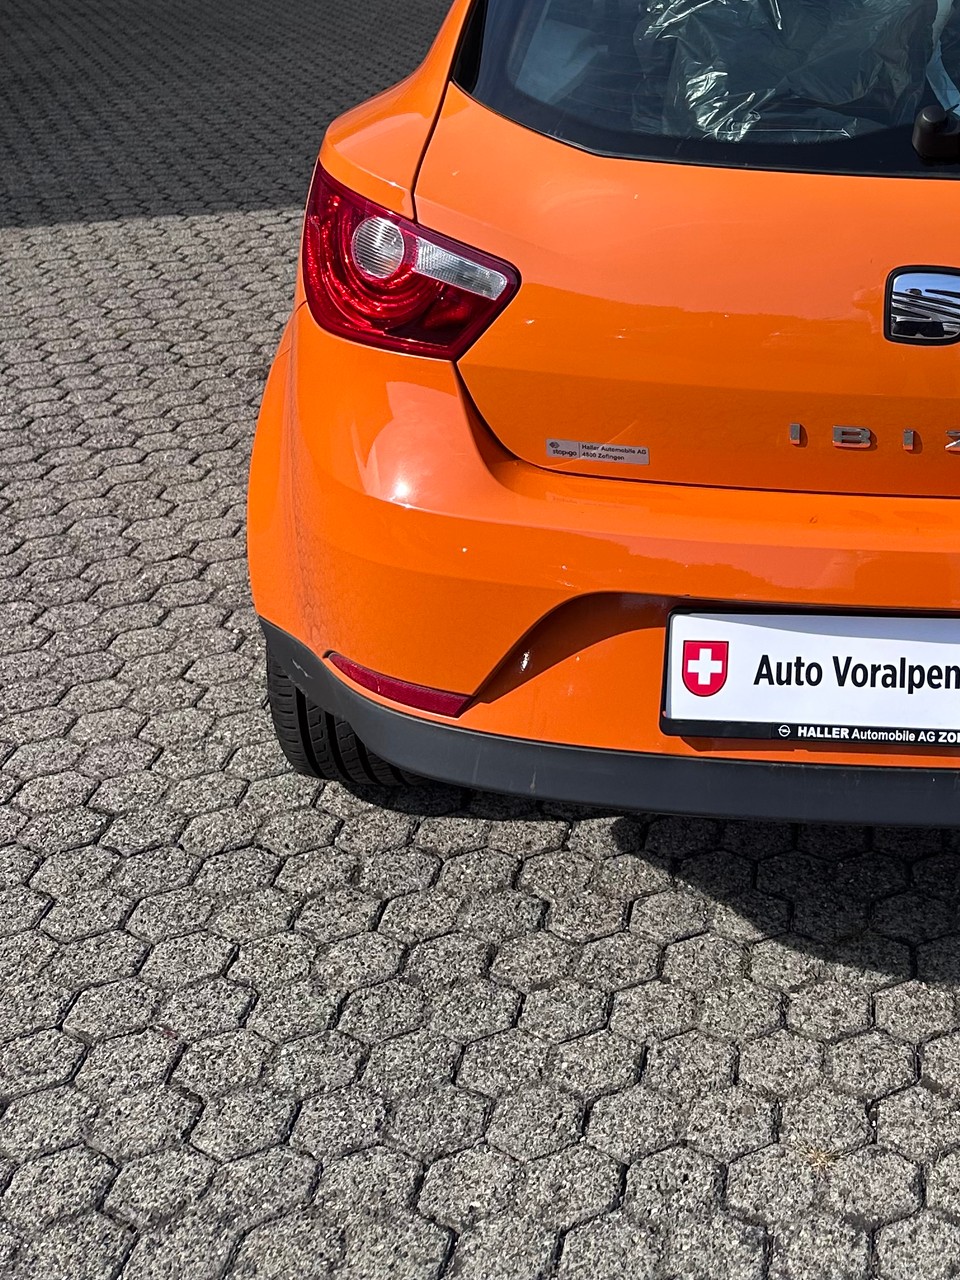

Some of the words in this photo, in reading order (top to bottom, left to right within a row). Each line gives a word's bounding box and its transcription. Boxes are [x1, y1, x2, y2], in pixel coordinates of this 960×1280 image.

[601, 446, 635, 454] Automobile
[598, 453, 625, 461] Zofingen
[753, 655, 823, 687] Auto
[832, 656, 960, 695] Voralpen
[797, 726, 850, 739] HALLER
[851, 728, 916, 742] Automobile
[917, 731, 936, 743] AG
